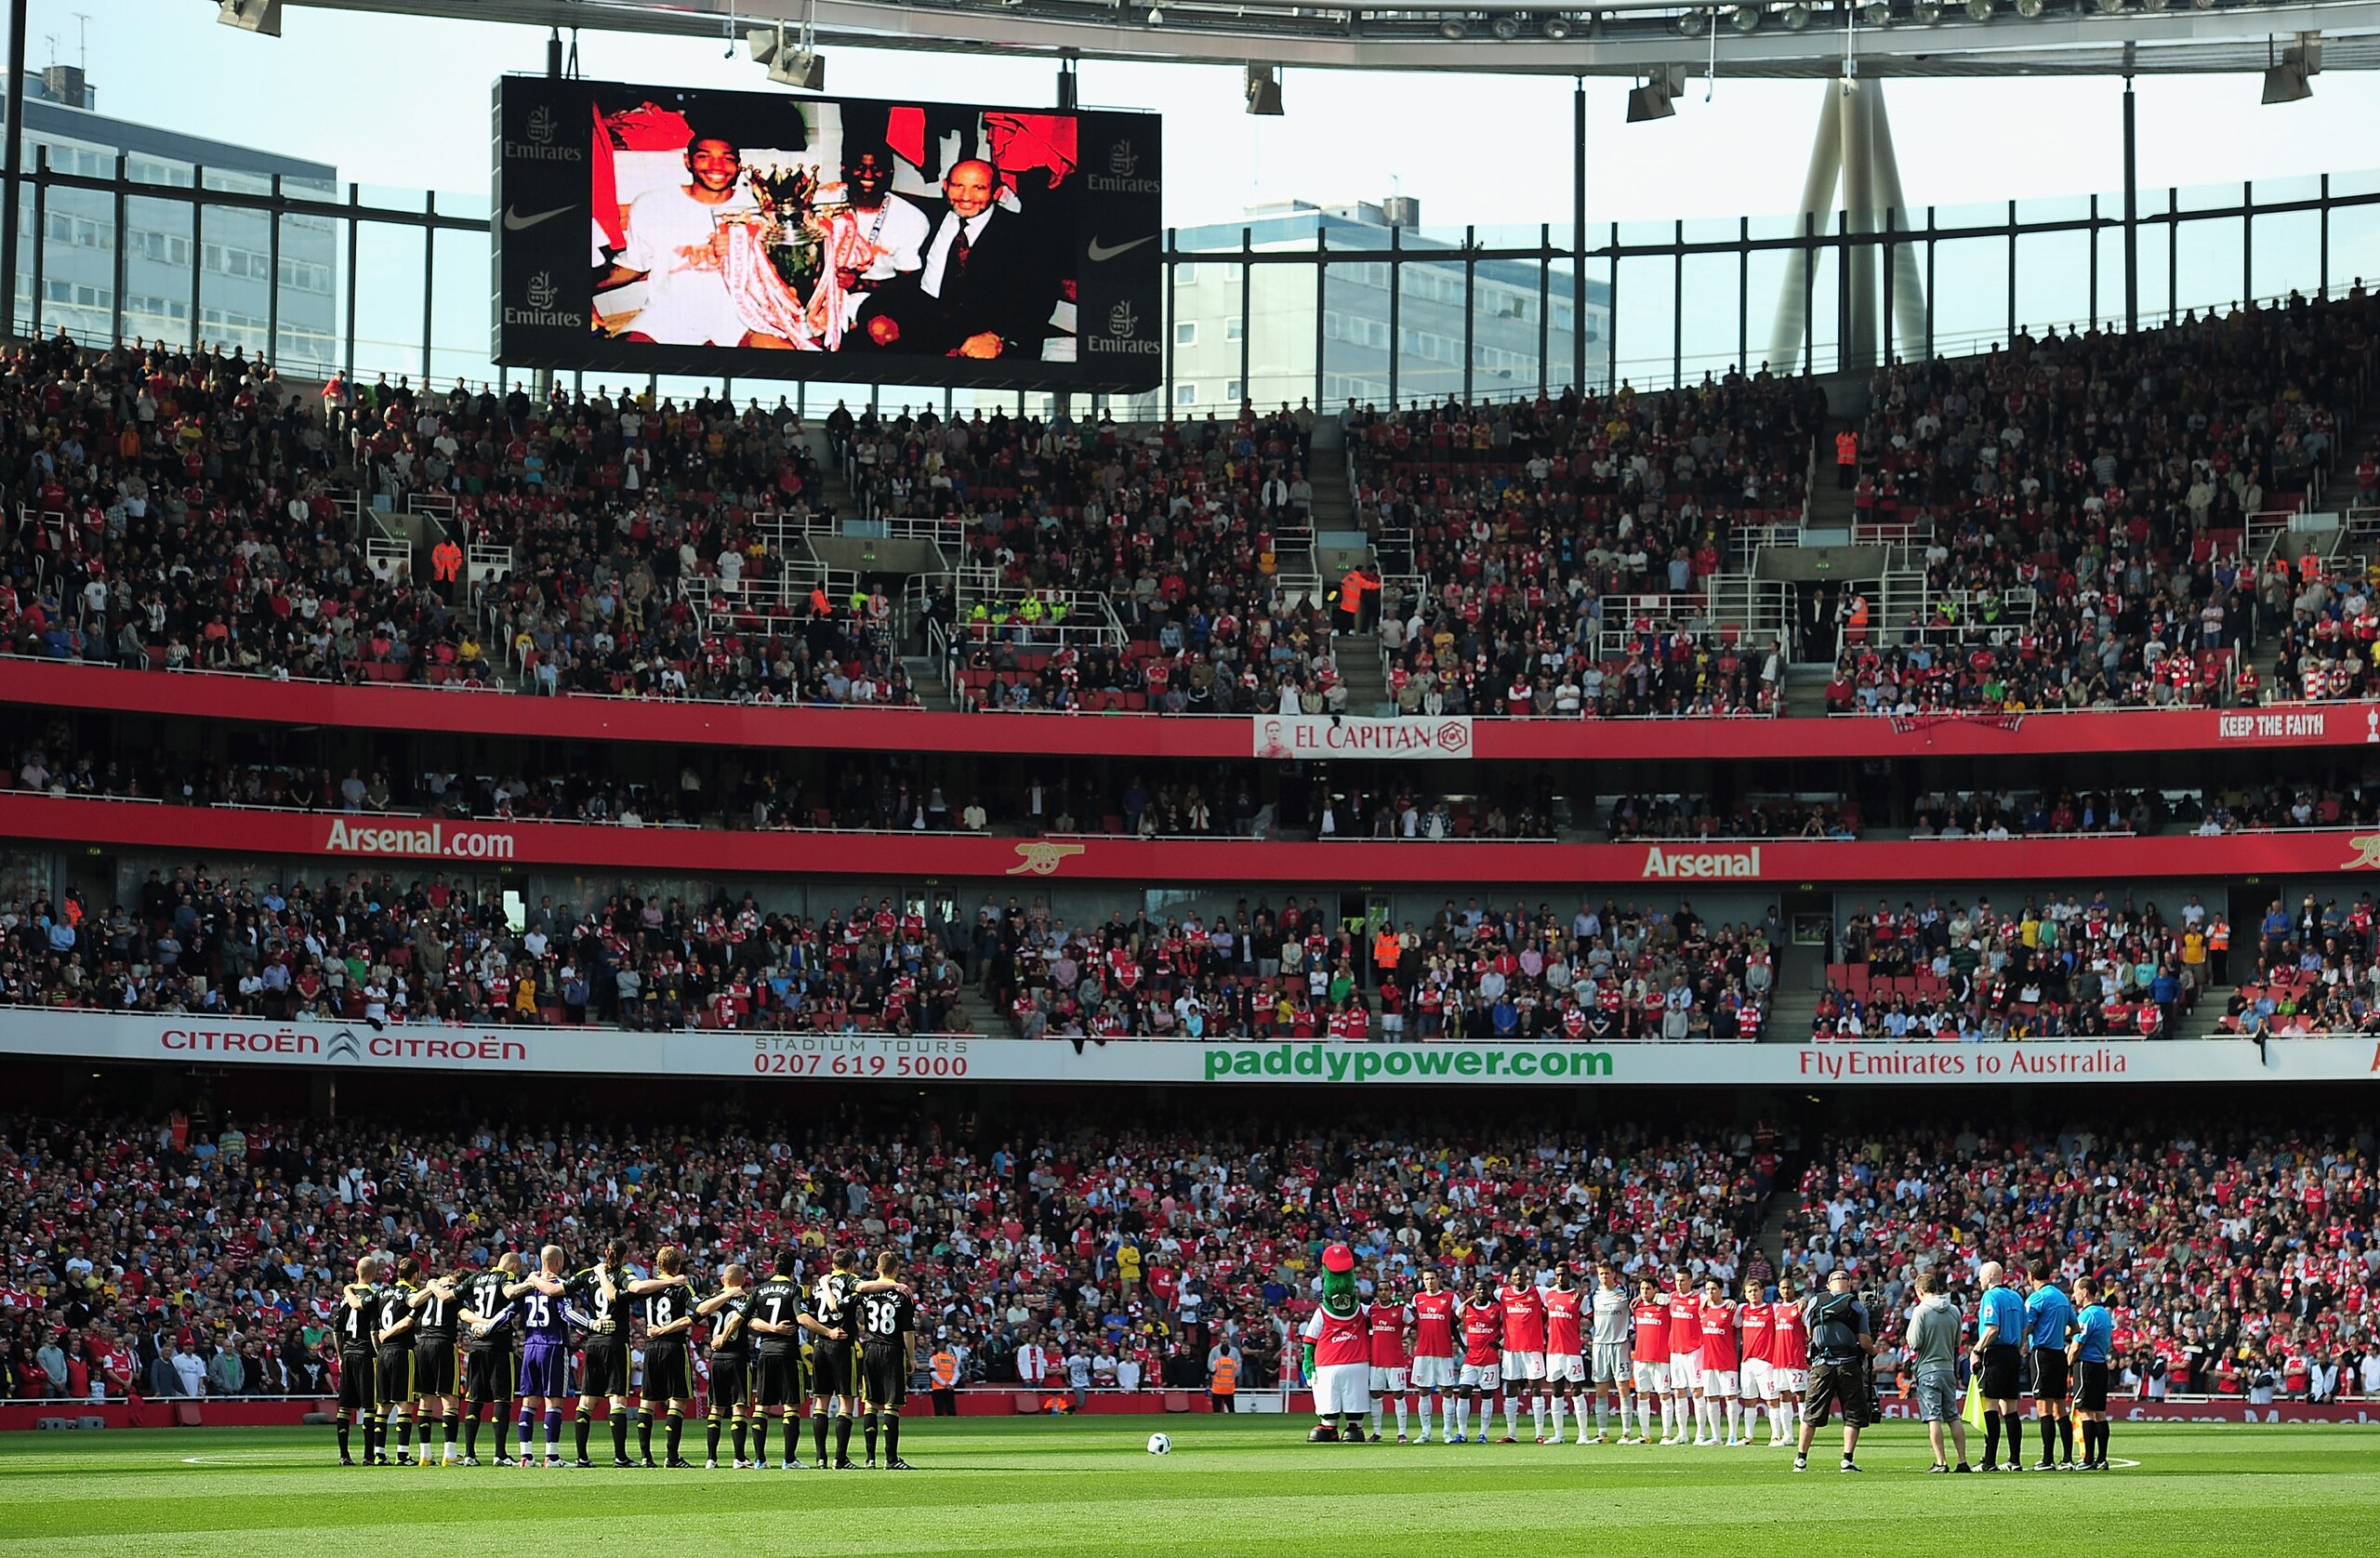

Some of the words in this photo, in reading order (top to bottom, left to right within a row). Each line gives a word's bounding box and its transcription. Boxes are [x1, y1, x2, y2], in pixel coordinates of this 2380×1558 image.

[504, 140, 582, 161] Emirates
[1088, 174, 1160, 193] Emirates
[504, 307, 582, 326] Emirates
[1088, 335, 1160, 354] Emirates
[1295, 725, 1319, 747] EL
[1326, 725, 1431, 749] CAPITAN
[2219, 715, 2254, 737] KEEP
[2256, 715, 2283, 736] THE
[2286, 714, 2324, 735] FAITH
[325, 818, 514, 858] Arsenal.com
[1642, 846, 1761, 878] Arsenal
[755, 1037, 866, 1051] STADIUM
[879, 1040, 968, 1054] TOURS
[754, 1053, 821, 1075] 0207
[831, 1054, 886, 1076] 619
[897, 1056, 968, 1076] 5000
[1205, 1045, 1613, 1082] paddypower.com
[1799, 1050, 1844, 1079] Fly
[1848, 1050, 1965, 1075] Emirates
[1977, 1052, 2002, 1074] to
[2009, 1049, 2126, 1074] Australia
[473, 1285, 496, 1318] 37
[593, 1288, 609, 1318] 9
[759, 1286, 790, 1297] SUAREZ
[381, 1301, 393, 1331] 6
[524, 1296, 549, 1327] 25
[645, 1296, 672, 1327] 18
[765, 1297, 782, 1327] 7
[866, 1301, 896, 1335] 38
[345, 1308, 358, 1339] 4
[1397, 1373, 1405, 1382] 14
[1484, 1372, 1495, 1382] 27
[1536, 1362, 1540, 1371] 2
[1572, 1364, 1582, 1375] 20
[1620, 1362, 1630, 1373] 53
[1696, 1369, 1700, 1380] 6
[1792, 1373, 1804, 1383] 22
[1730, 1378, 1735, 1387] 8
